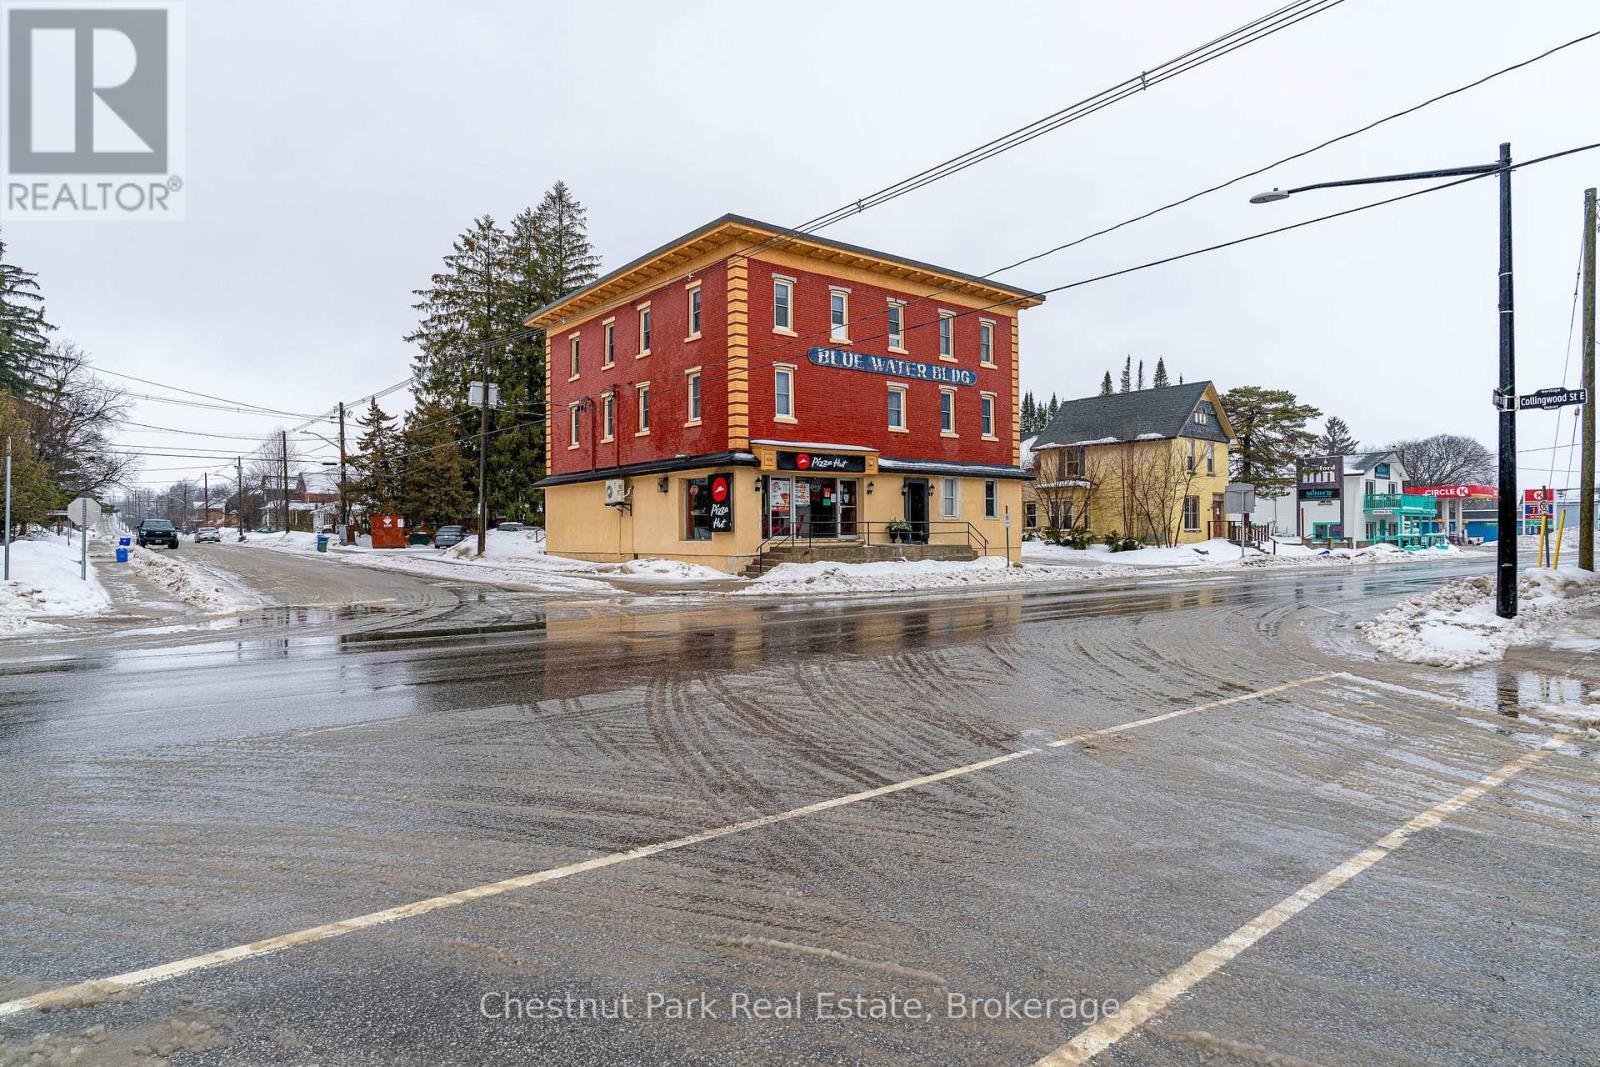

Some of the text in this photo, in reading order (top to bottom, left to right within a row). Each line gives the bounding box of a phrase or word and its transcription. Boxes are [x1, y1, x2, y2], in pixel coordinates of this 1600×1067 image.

[818, 348, 970, 384] BLUE WATER BLDG
[1520, 391, 1585, 406] Collingwood St E
[811, 456, 848, 468] Pizza Hut
[1425, 489, 1455, 497] CIRCLE
[711, 503, 729, 516] Pizza
[713, 517, 727, 528] Hut
